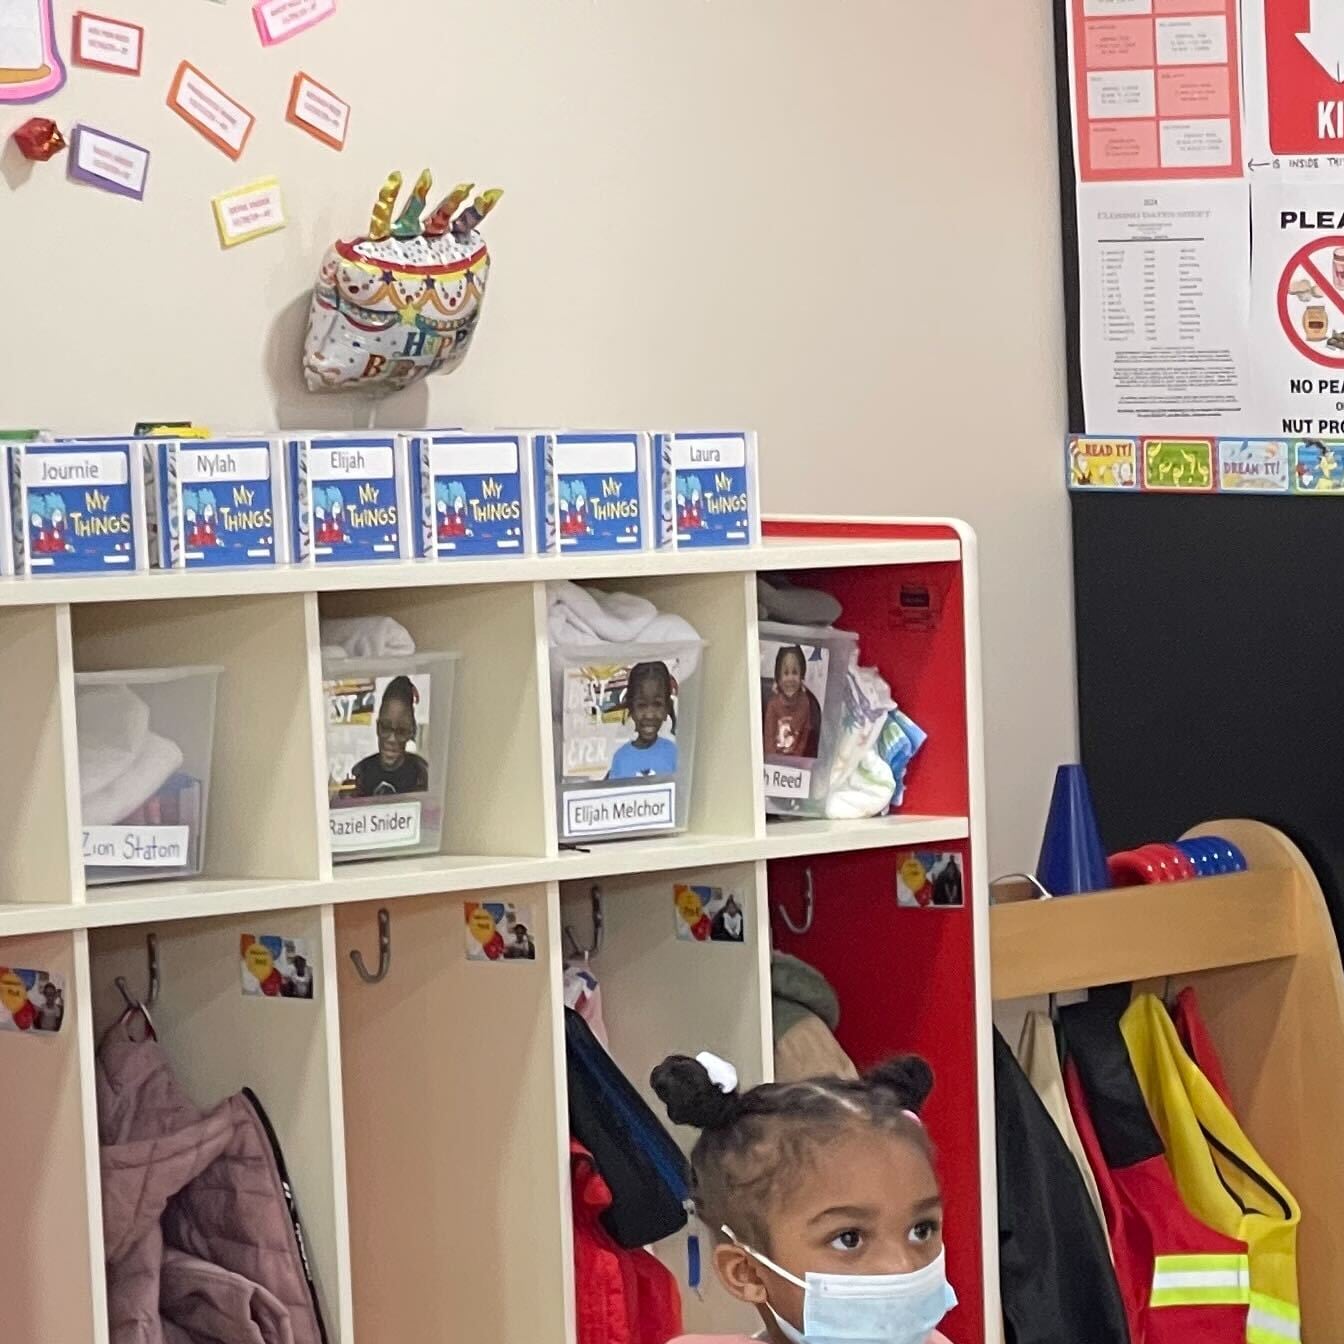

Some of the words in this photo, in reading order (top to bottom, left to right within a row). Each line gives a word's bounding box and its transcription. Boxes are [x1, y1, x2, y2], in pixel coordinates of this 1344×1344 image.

[1289, 158, 1319, 168] INSIDE
[1290, 379, 1313, 395] NO
[1282, 419, 1312, 434] NUT
[689, 445, 721, 463] Laura
[1085, 443, 1113, 457] READ
[42, 460, 99, 481] Journie
[197, 453, 237, 476] Nylah
[330, 451, 366, 472] Elijah
[1223, 461, 1258, 475] DREAM
[482, 477, 502, 500] MY
[602, 477, 622, 499] MY
[714, 472, 734, 493] MY
[85, 489, 110, 513] MY
[232, 485, 256, 507] MY
[358, 483, 380, 506] MY
[703, 492, 747, 515] THINGS
[219, 507, 272, 532] THINGS
[347, 505, 397, 528] THINGS
[469, 499, 520, 523] THINGS
[590, 498, 638, 519] THINGS
[69, 512, 131, 537] THINGS
[772, 771, 802, 789] Reed
[329, 815, 366, 836] Raziel
[370, 812, 412, 833] Snider
[575, 806, 609, 825] Elijah
[612, 801, 665, 821] Melchor
